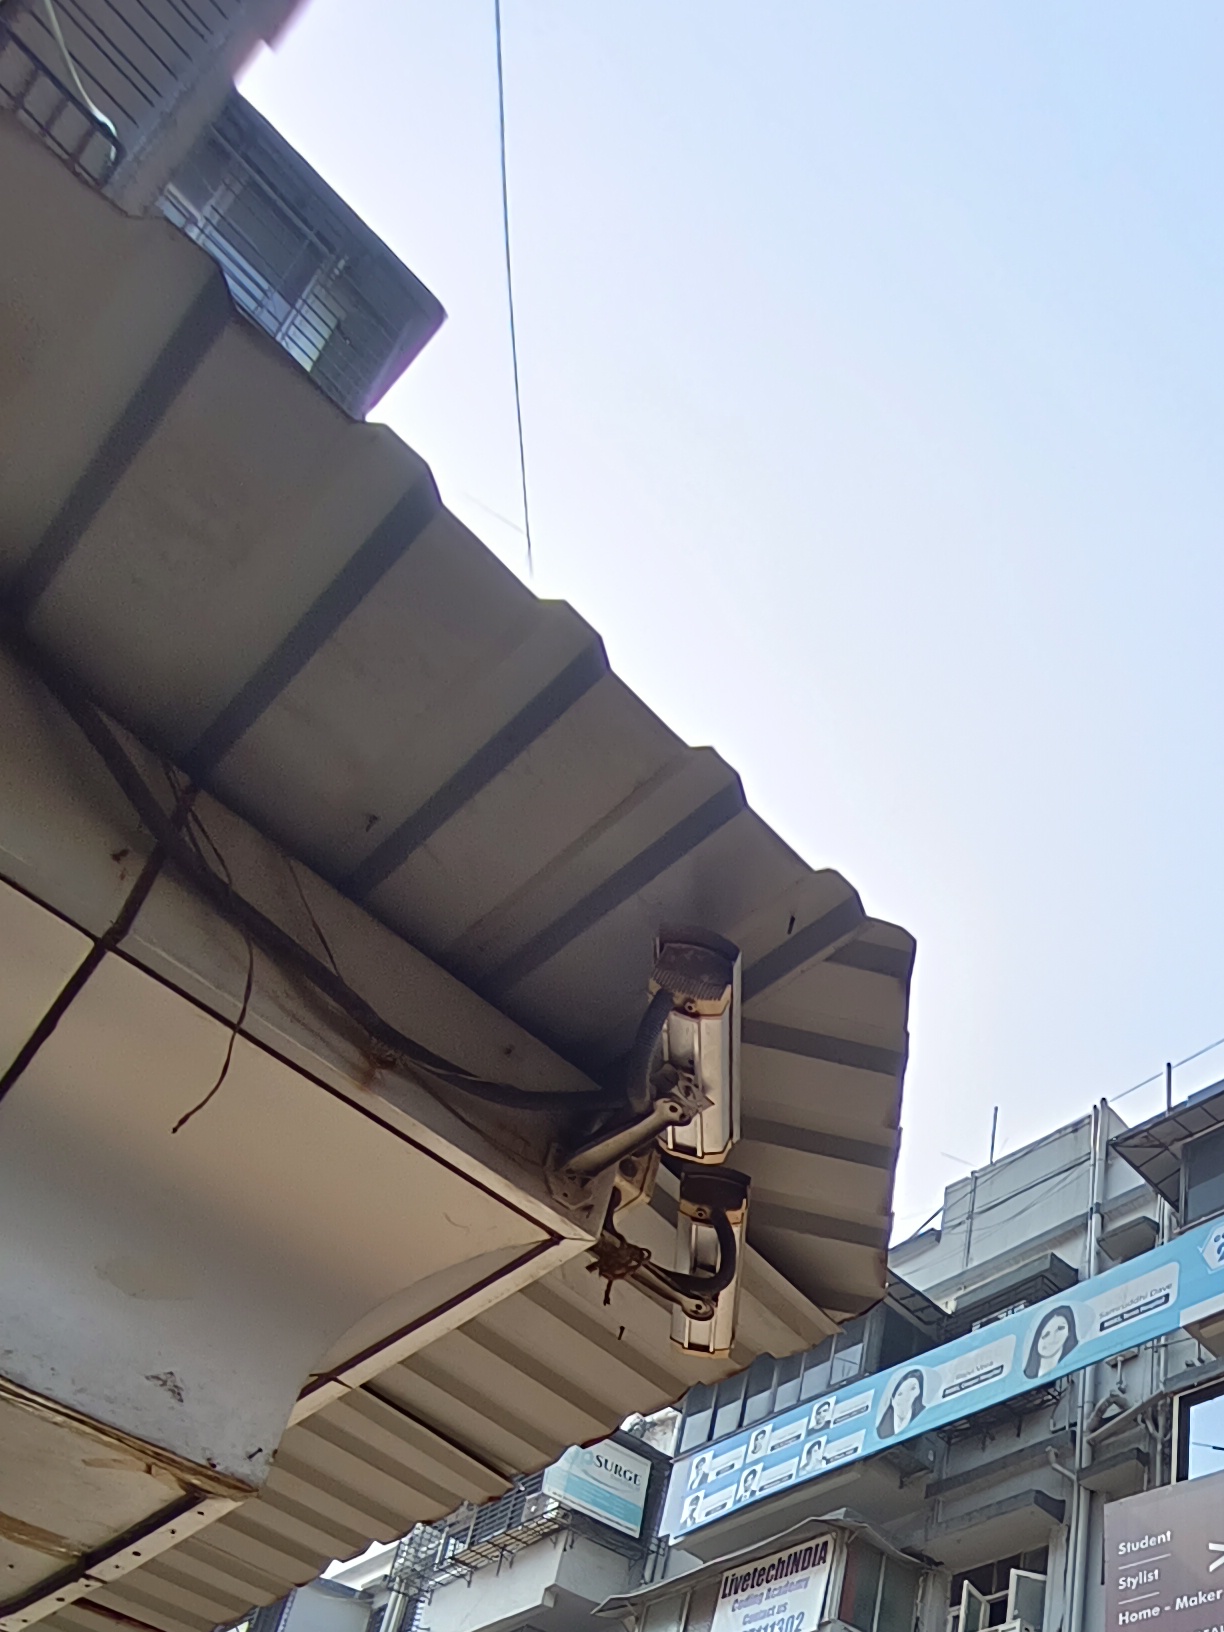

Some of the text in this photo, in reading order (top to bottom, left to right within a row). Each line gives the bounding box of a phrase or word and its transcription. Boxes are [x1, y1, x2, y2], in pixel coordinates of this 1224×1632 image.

[594, 1454, 643, 1486] SURGE
[1118, 1531, 1172, 1556] Student
[721, 1540, 829, 1600] LivetechINDIA
[1118, 1569, 1160, 1592] Stylist
[1118, 1588, 1224, 1626] Home Maker
